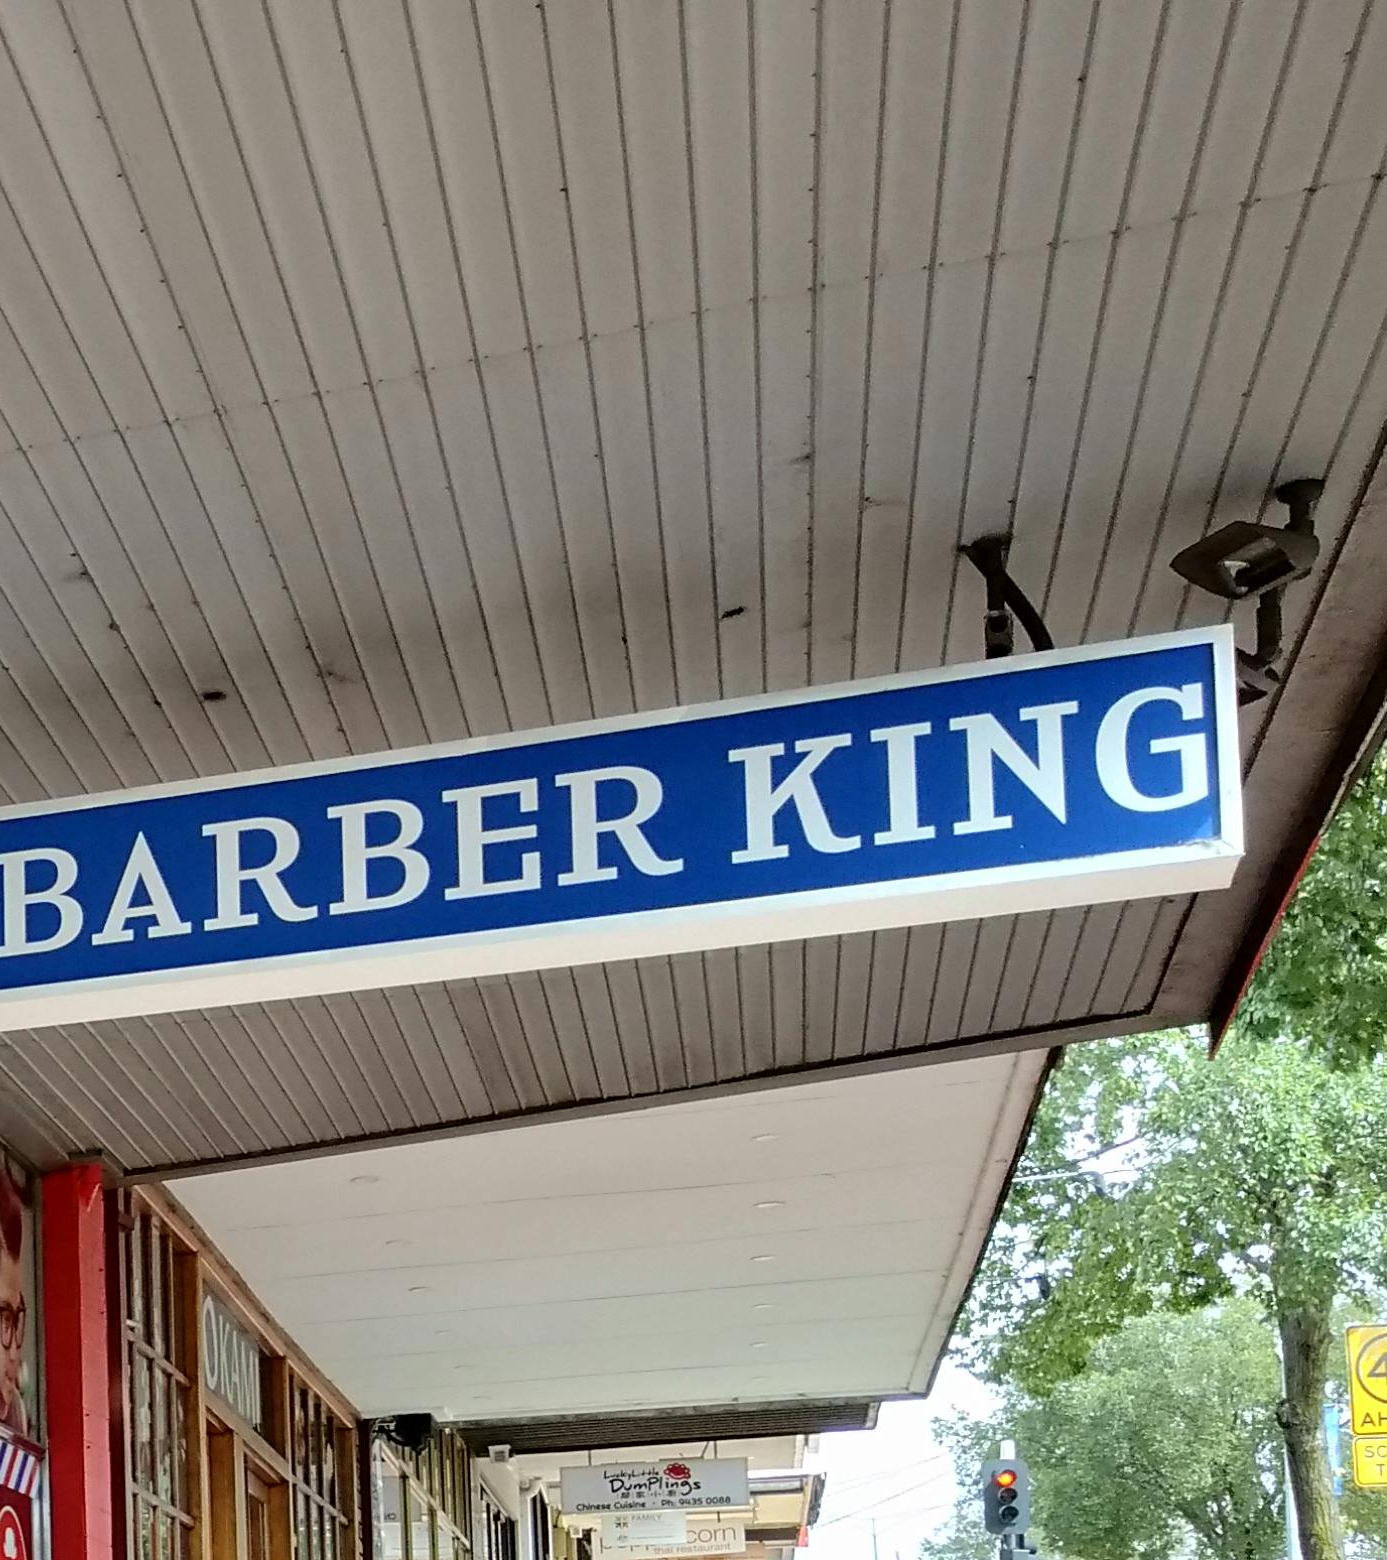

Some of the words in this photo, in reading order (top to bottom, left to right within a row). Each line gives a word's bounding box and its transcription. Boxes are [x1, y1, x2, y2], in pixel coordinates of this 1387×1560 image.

[727, 681, 1211, 865] KING
[203, 1295, 261, 1425] OKAMI
[576, 1503, 611, 1512] Chinese
[614, 1501, 646, 1511] Cuisine
[679, 1498, 703, 1506] 9435
[676, 1543, 732, 1553] restaurant
